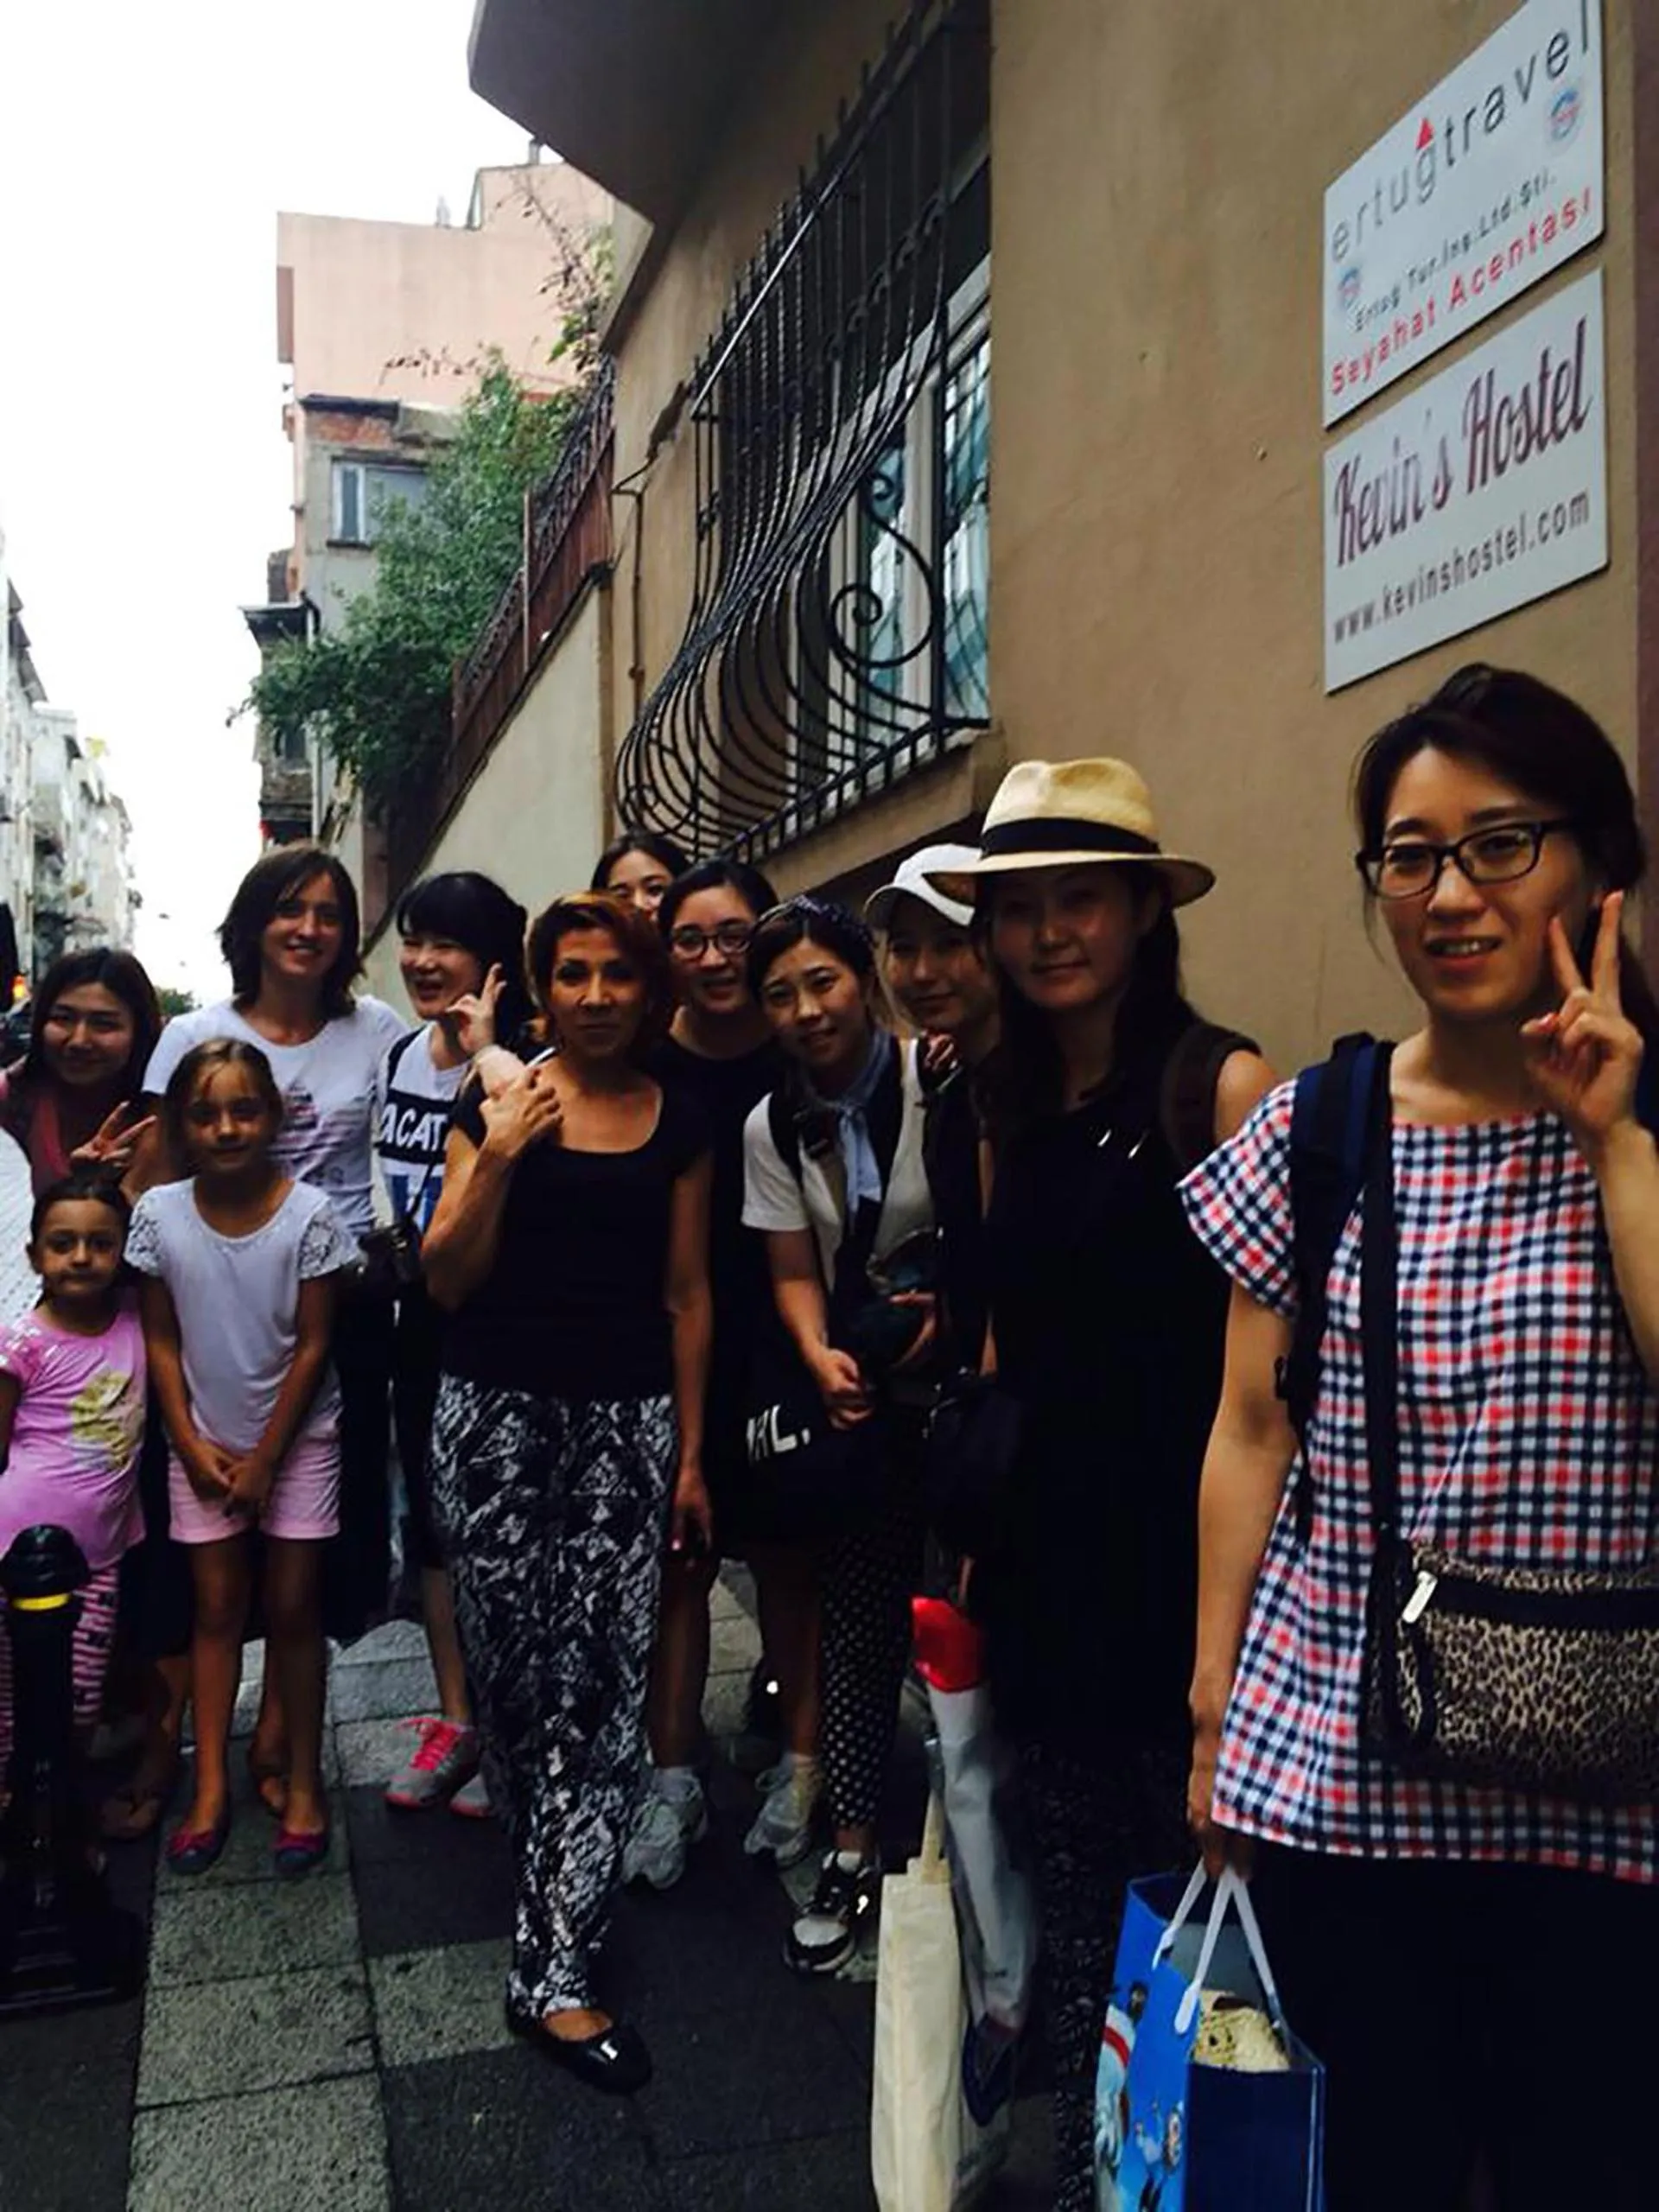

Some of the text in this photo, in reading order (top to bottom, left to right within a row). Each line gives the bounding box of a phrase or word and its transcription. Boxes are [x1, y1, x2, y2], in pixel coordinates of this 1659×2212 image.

[1334, 314, 1593, 567] Kevin's Hostel
[1334, 488, 1590, 645] www.kevinshostel.com
[378, 1102, 448, 1153] ACAT
